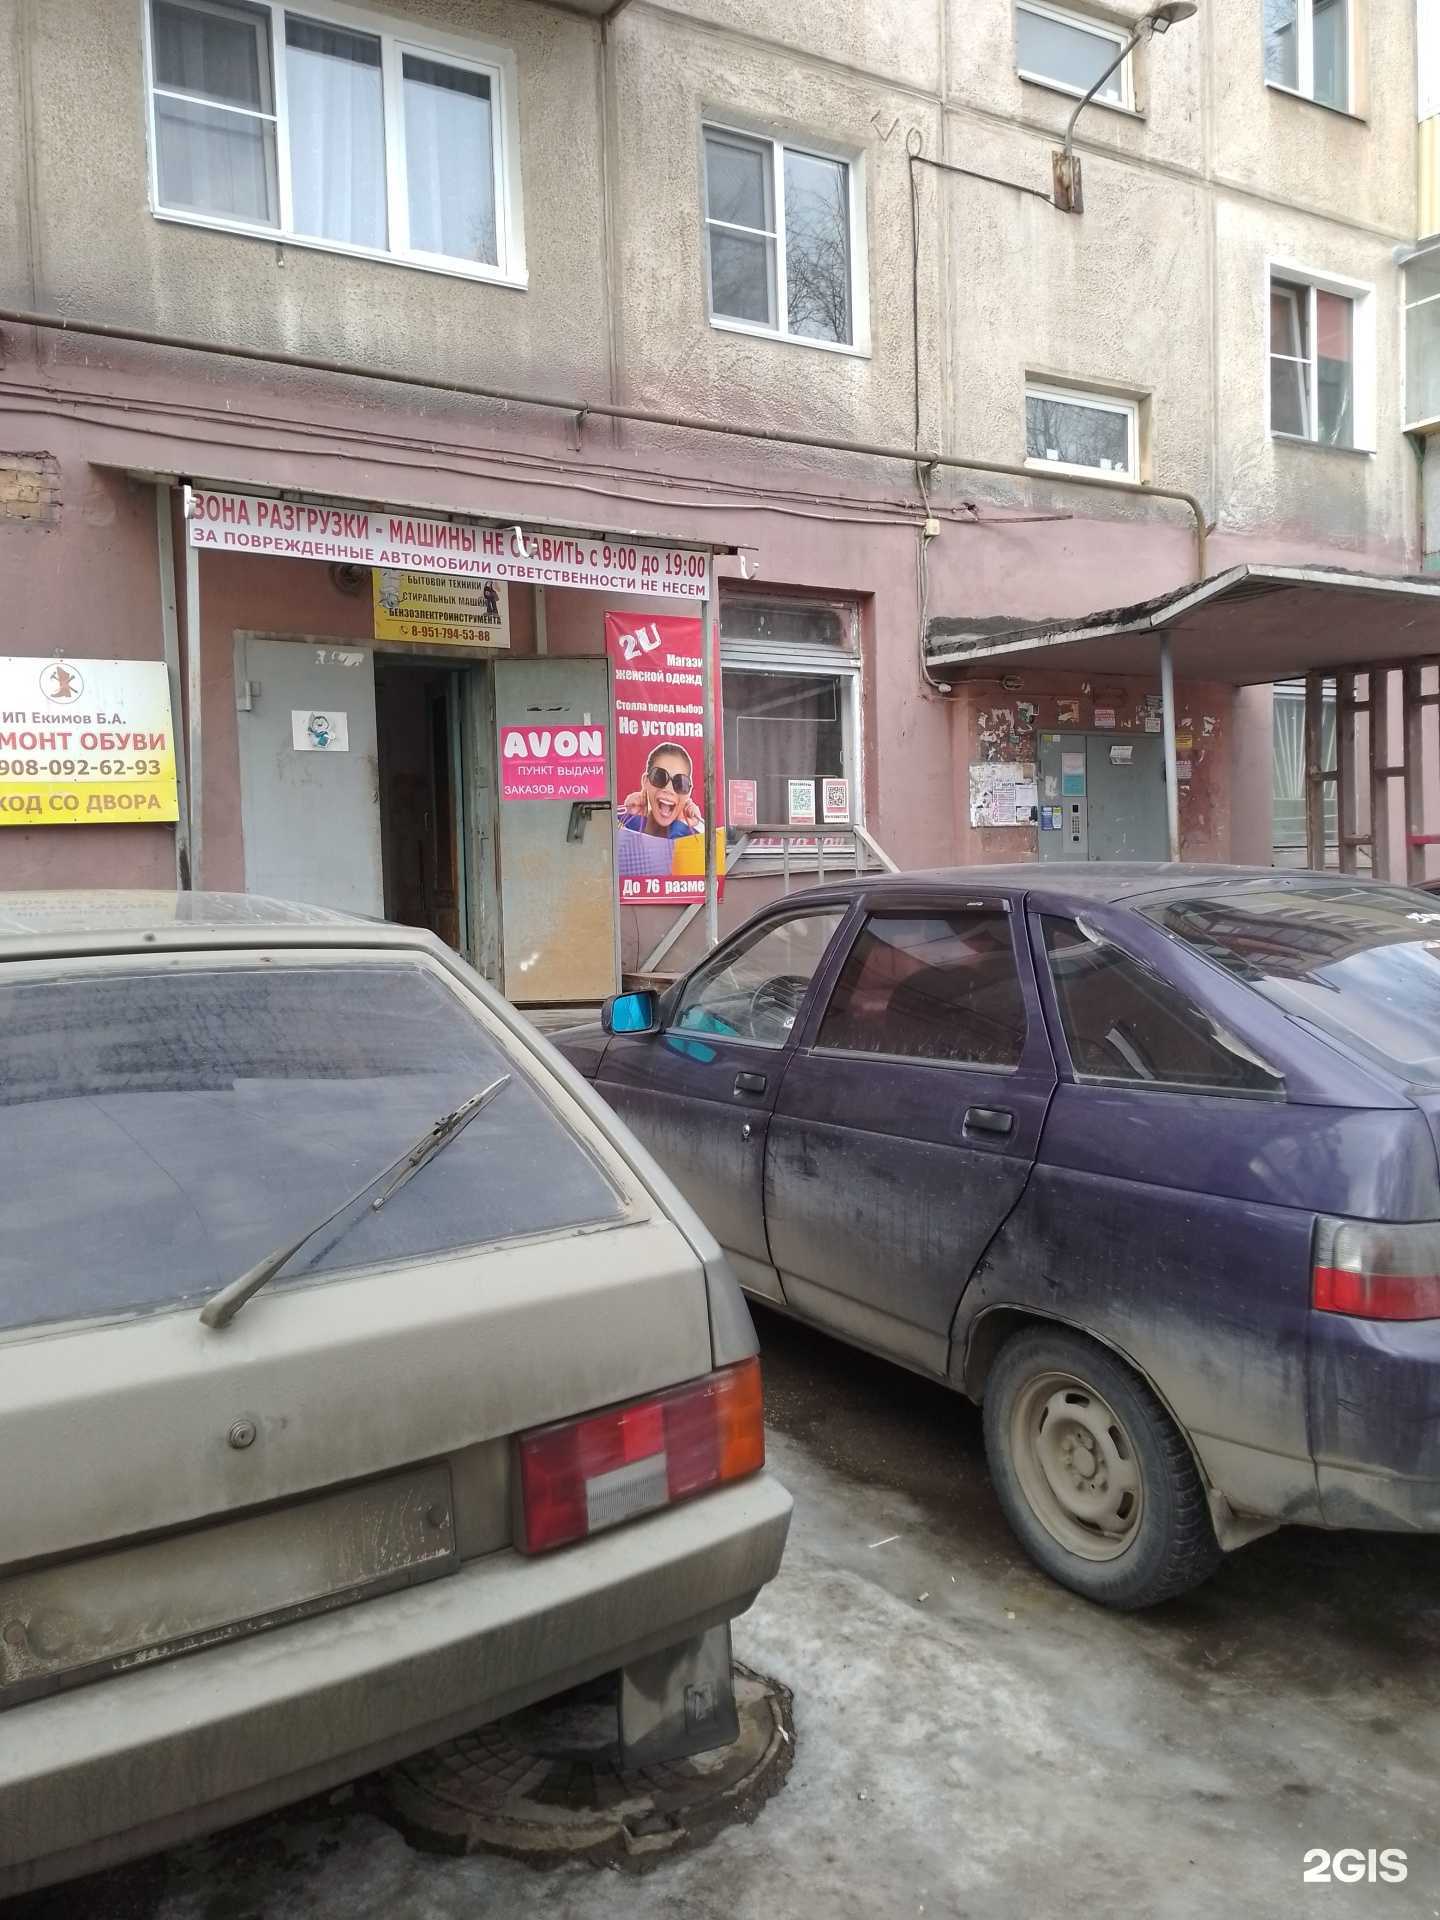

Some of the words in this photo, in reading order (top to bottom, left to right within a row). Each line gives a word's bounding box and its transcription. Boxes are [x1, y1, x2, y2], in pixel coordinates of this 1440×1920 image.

[193, 493, 250, 526] ЗОНА
[257, 501, 369, 541] РАЗГРУЗКИ
[389, 518, 476, 553] МАШИНЫ
[482, 529, 504, 556] НЕ
[602, 545, 636, 571] 9:00
[641, 556, 659, 576] до
[665, 552, 705, 578] 19:00
[193, 528, 217, 543] ЗА
[224, 531, 374, 561] ПОВРЕЖДЕННЫЕ
[379, 551, 491, 574] АВТОМОБИЛИ
[496, 563, 635, 589] ОТВЕТСТВЕННОСТИ
[641, 578, 657, 591] НЕ
[662, 581, 705, 597] НЕСЕМ
[449, 579, 482, 590] ТЕХНИКИ
[402, 592, 456, 605] СТИРАЛЬНЫХ
[411, 626, 490, 642] 8-951-794-53-88
[619, 622, 662, 661] 2U
[666, 653, 704, 668] Магази
[616, 669, 664, 683] женской
[666, 672, 703, 686] одежд
[616, 700, 647, 711] Стояла
[648, 703, 675, 714] перед
[3, 711, 26, 724] ИП
[32, 712, 92, 725] Екимов
[97, 713, 126, 725] Б.А.
[619, 716, 638, 735] Не
[642, 720, 704, 737] устояла
[80, 733, 166, 751] ОБУВИ
[503, 730, 603, 758] AVON
[518, 766, 553, 776] ПУНКТ
[557, 765, 604, 777] ВЫДАЧИ
[504, 784, 555, 795] ЗАКАЗОВ
[558, 785, 589, 794] AVON
[49, 795, 79, 811] СО
[87, 794, 161, 813] ДВОРА
[622, 879, 641, 896] До
[645, 879, 660, 893] 76
